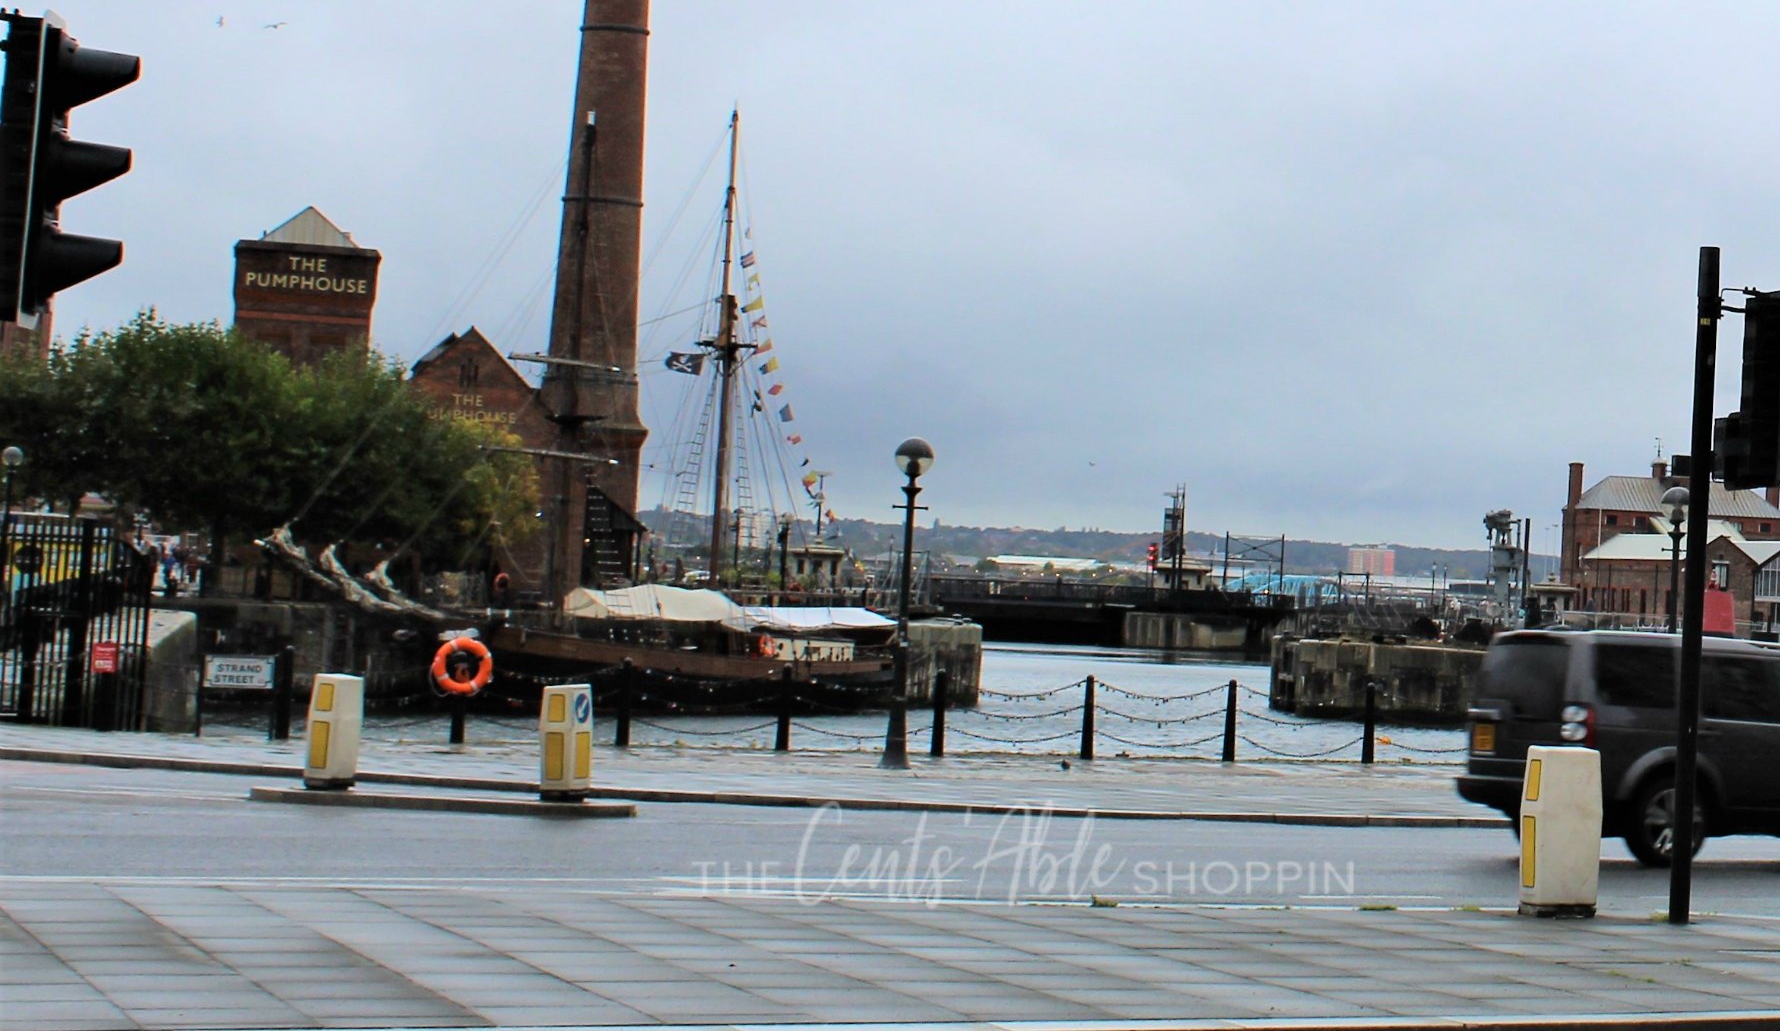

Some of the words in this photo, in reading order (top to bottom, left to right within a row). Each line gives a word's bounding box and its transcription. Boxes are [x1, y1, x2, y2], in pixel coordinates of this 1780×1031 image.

[289, 256, 327, 272] THE
[245, 272, 367, 294] PUMPHOUSE
[452, 394, 483, 407] THE
[217, 664, 262, 673] STRAND
[214, 674, 255, 684] STREET
